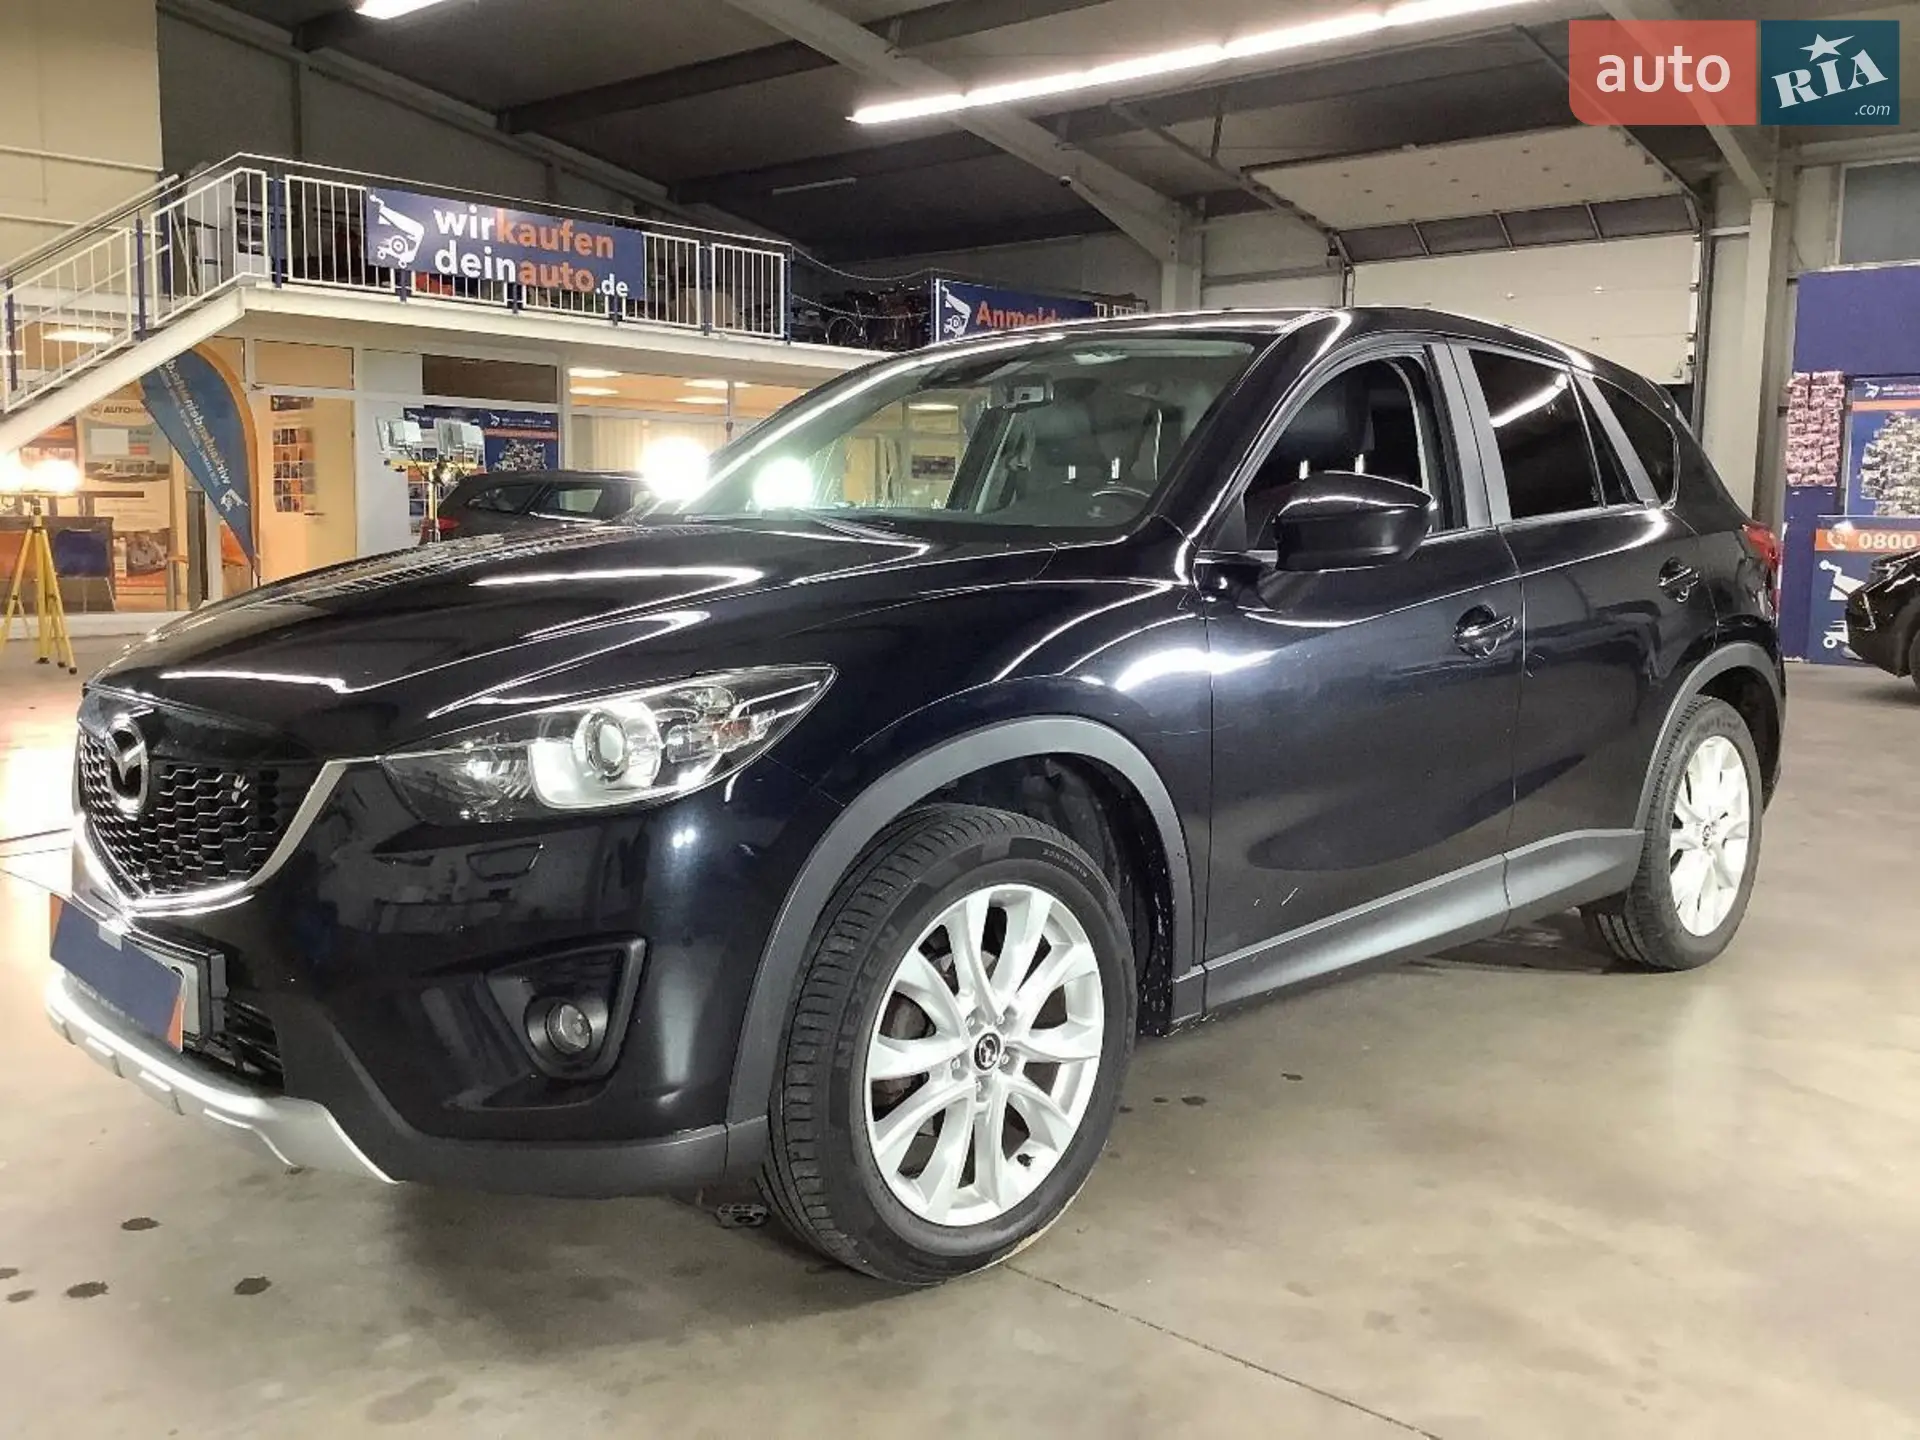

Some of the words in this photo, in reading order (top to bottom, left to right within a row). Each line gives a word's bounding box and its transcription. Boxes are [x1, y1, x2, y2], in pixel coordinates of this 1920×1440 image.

[433, 205, 614, 259] wirkaufen
[435, 240, 629, 297] deinauto.de
[976, 300, 1062, 328] Anmeld
[1859, 532, 1918, 550] 0800
